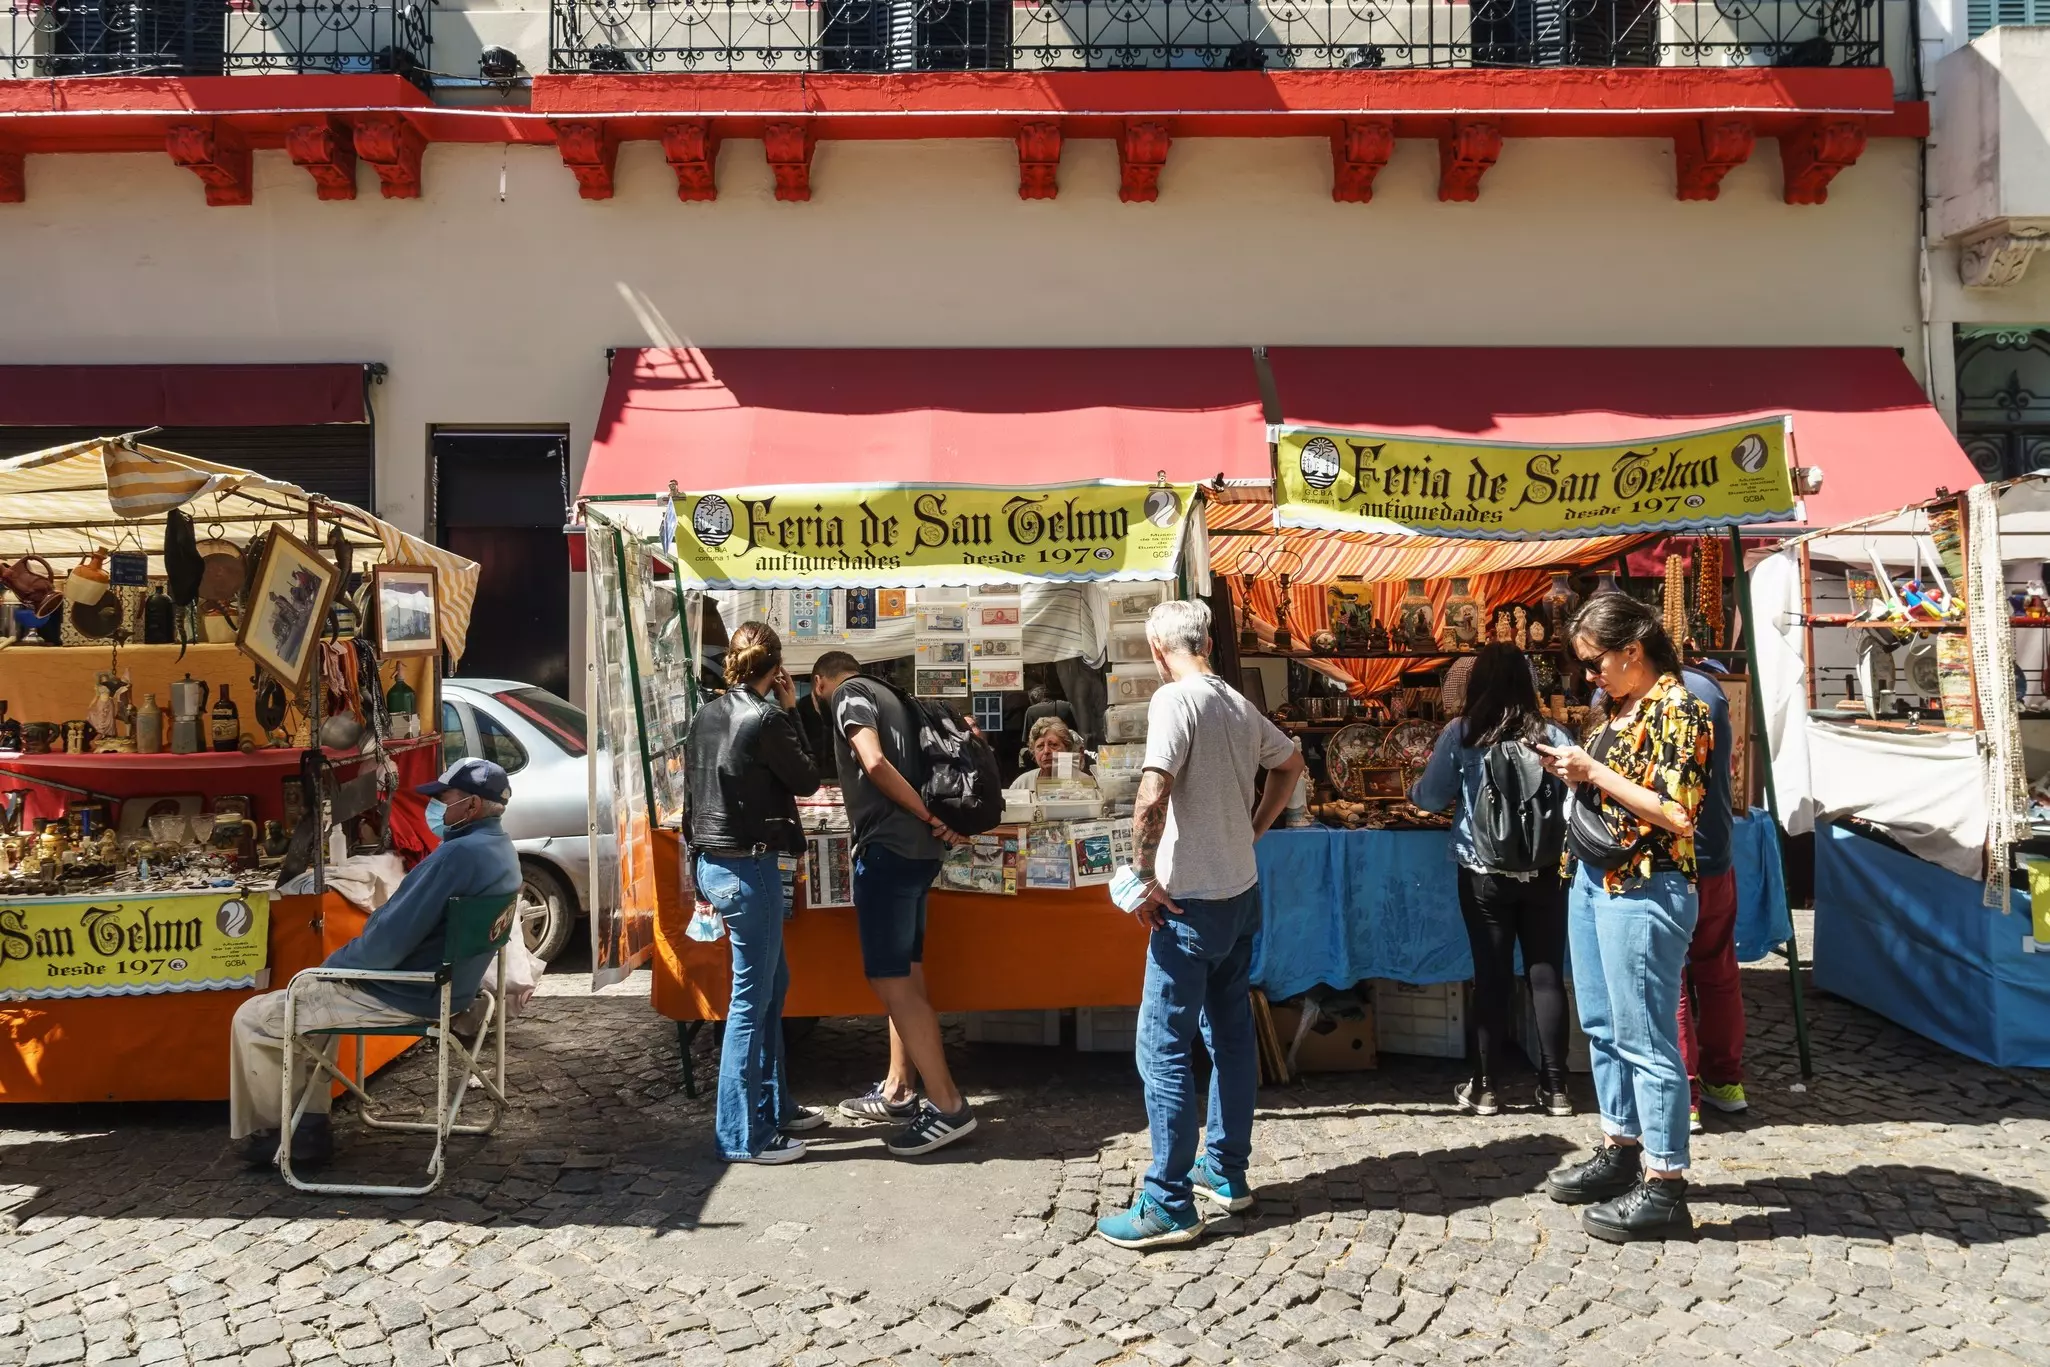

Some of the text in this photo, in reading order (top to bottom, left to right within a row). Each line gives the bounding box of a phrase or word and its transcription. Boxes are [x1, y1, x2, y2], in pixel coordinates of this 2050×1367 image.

[1339, 438, 1720, 512] Feria de San Telmo
[1359, 498, 1503, 524] antiguedades
[1563, 505, 1621, 521] desde
[1743, 494, 1766, 503] GCBA
[733, 493, 1130, 558] Feria de San Telmo
[755, 549, 901, 576] antiguedades
[962, 551, 1026, 565] desde
[0, 904, 203, 968] San Telmo
[47, 961, 107, 977] desde
[225, 959, 247, 967] GCBA
